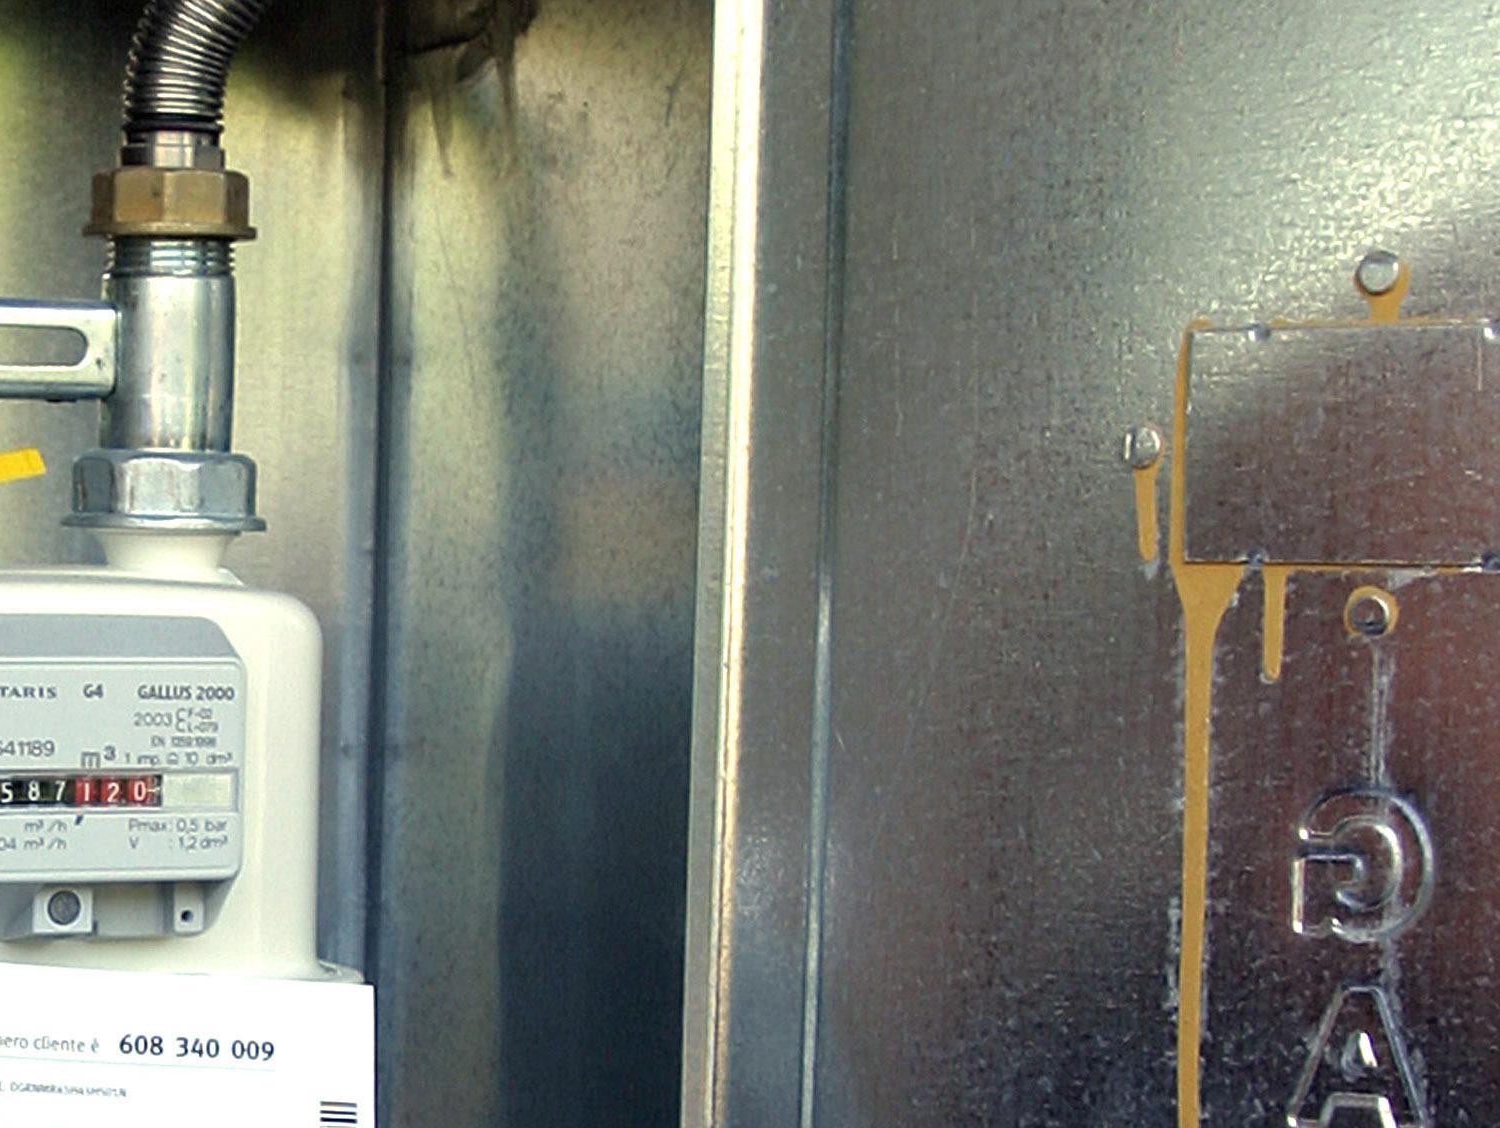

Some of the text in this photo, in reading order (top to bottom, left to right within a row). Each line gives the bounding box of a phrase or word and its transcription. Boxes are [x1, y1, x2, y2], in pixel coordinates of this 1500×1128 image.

[83, 684, 104, 699] G4
[137, 685, 235, 701] GALLUS 2000
[134, 712, 173, 727] 2003
[33, 1036, 86, 1053] cliente
[119, 1034, 164, 1057] 608
[176, 1036, 220, 1058] 340
[231, 1039, 275, 1062] 009
